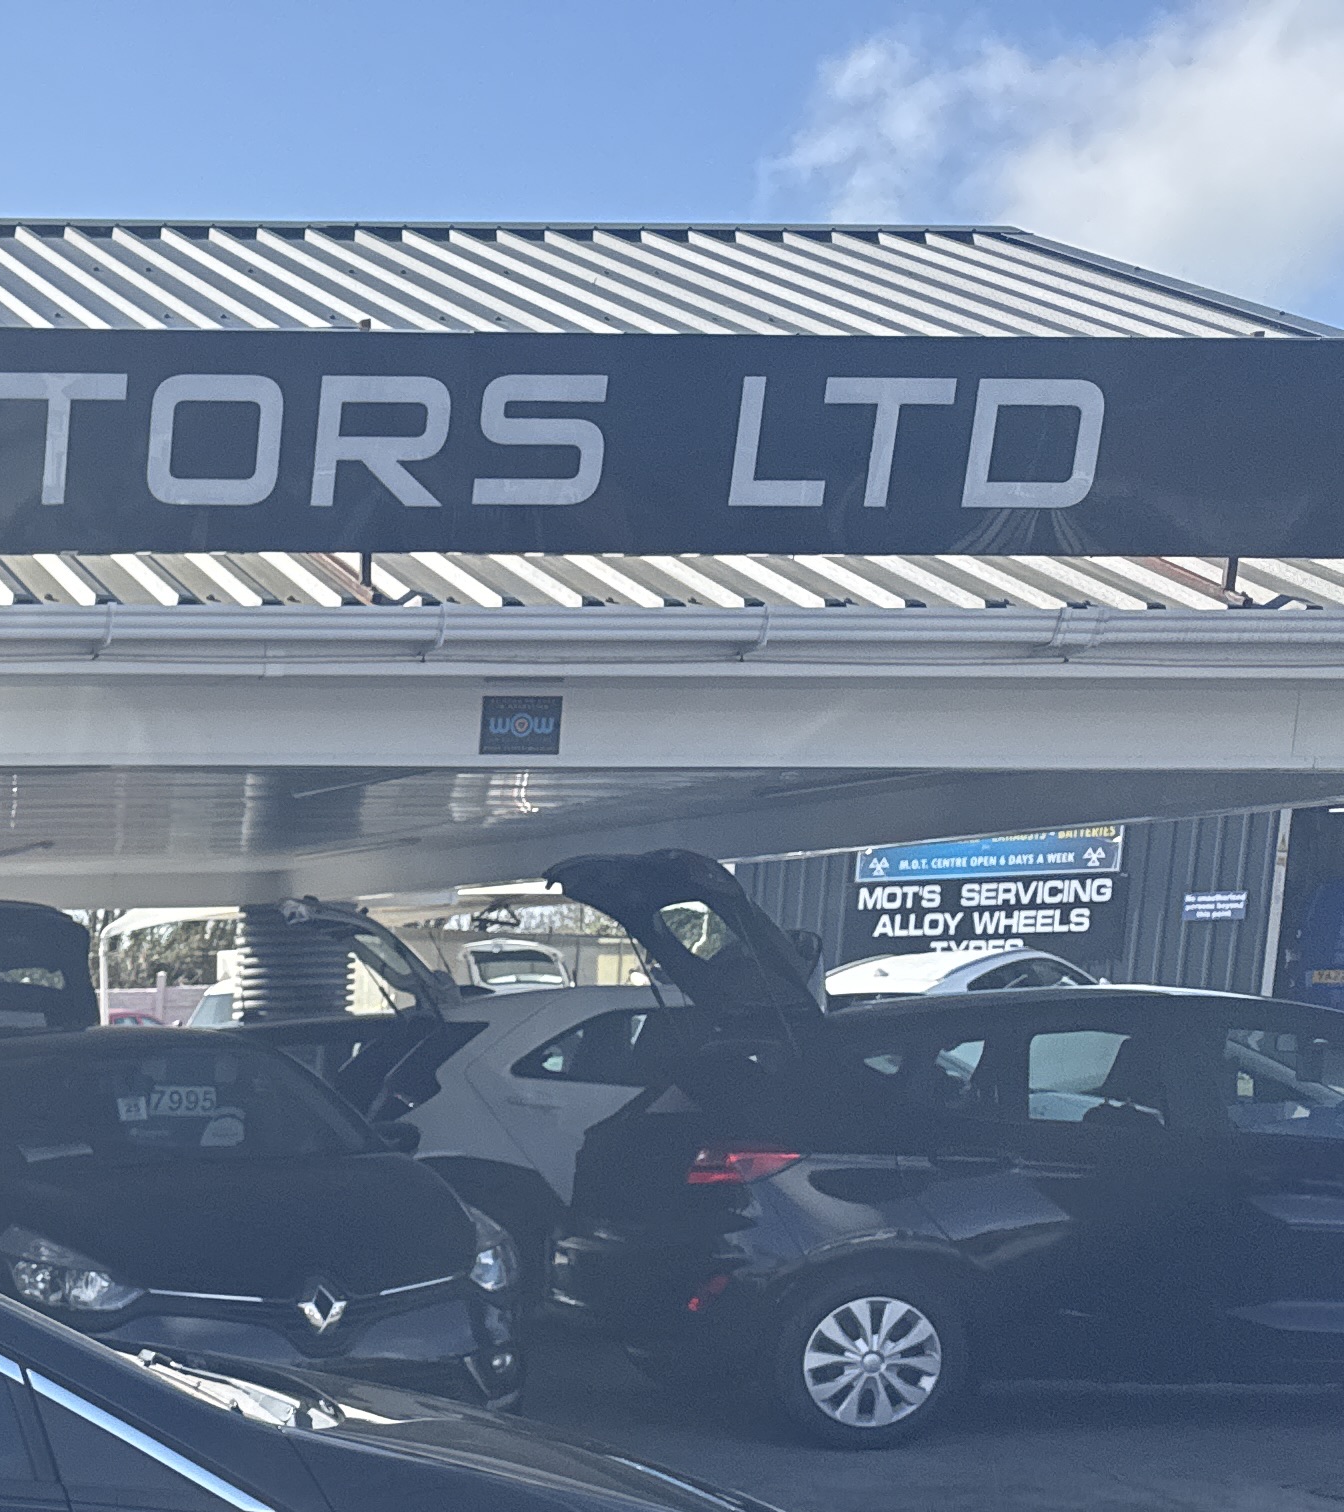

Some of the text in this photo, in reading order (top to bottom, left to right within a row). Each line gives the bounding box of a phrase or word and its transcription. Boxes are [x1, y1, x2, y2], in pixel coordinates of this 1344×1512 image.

[728, 376, 1106, 509] LTD
[898, 851, 1075, 871] M.O.T. CENTRE OPEN 6 DAYS A WEEK
[857, 878, 1113, 911] MOT'S SERVICING
[872, 907, 1091, 938] ALLOY WHEELS
[151, 1089, 215, 1112] 7995
